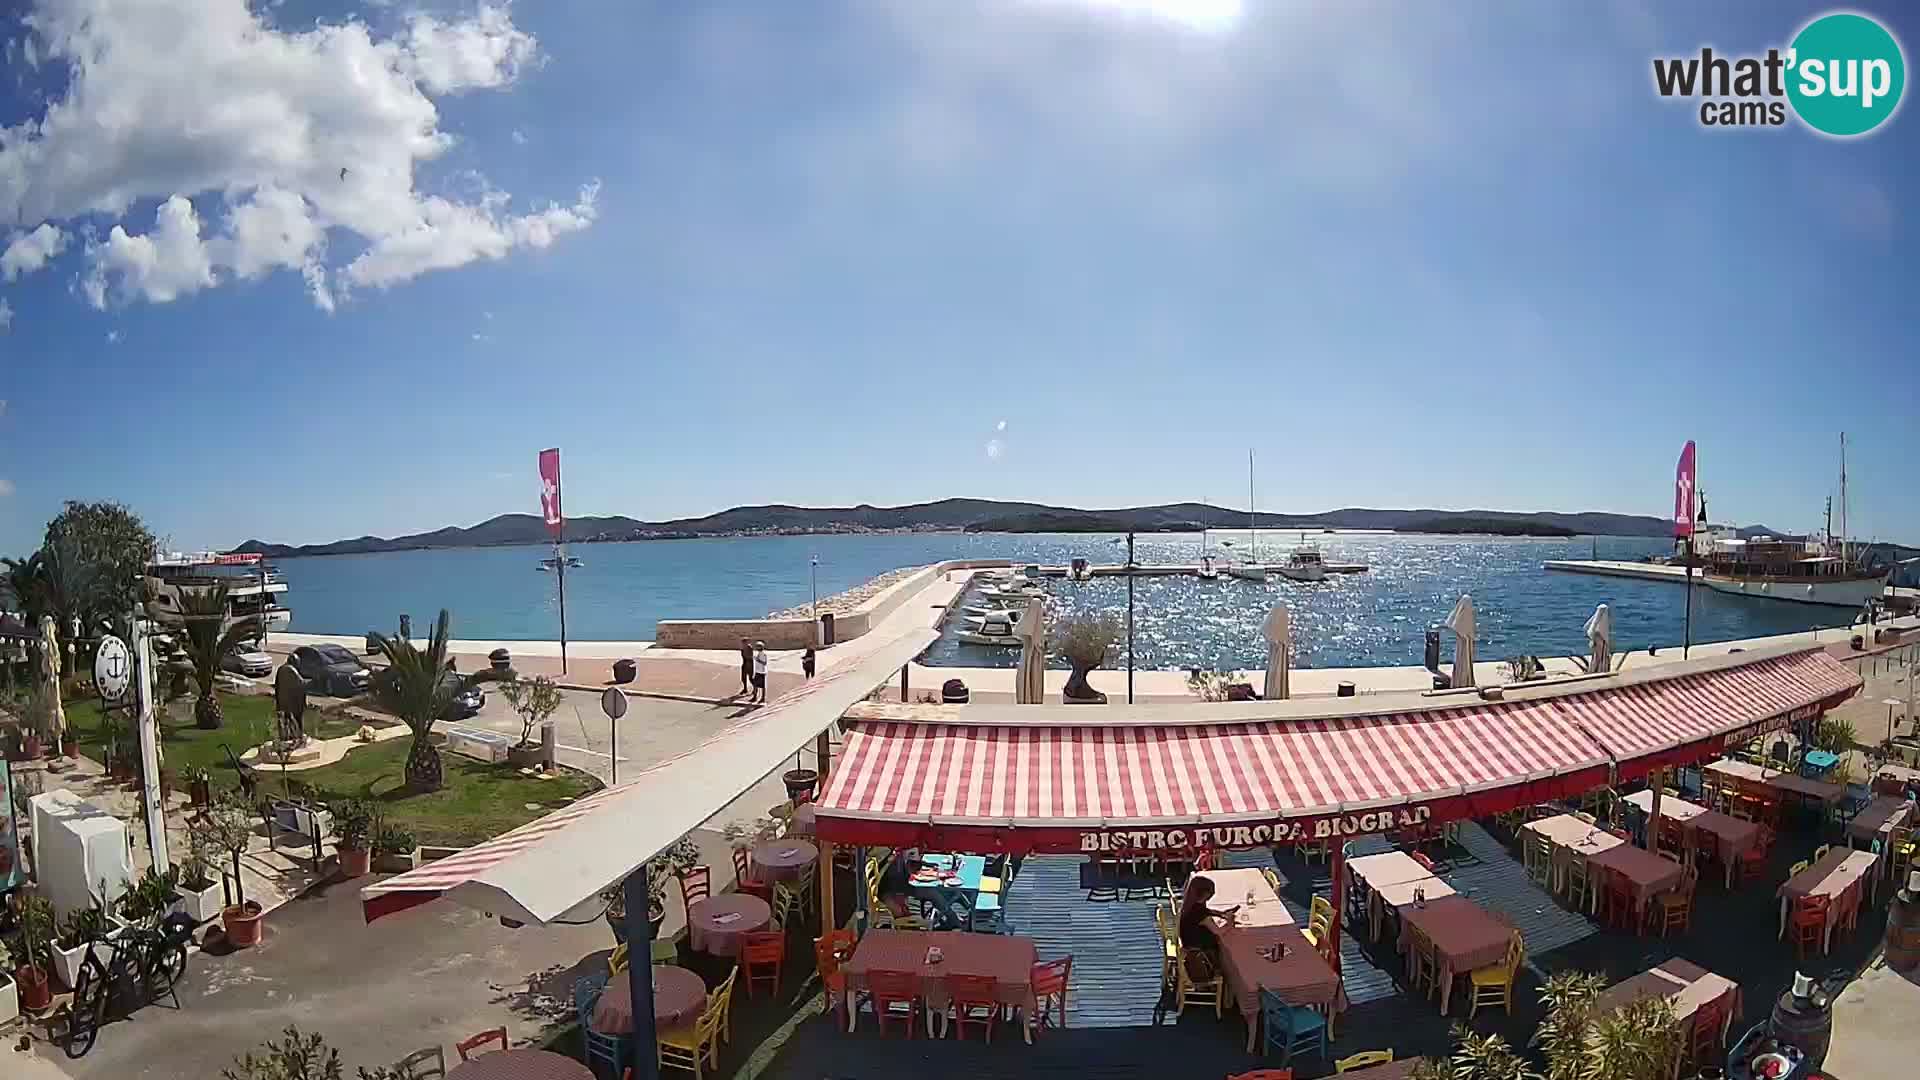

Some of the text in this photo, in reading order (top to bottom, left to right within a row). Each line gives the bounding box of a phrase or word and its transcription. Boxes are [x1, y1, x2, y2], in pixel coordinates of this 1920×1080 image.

[1080, 806, 1431, 851] BISTRO EUROPA BIOGRAD
